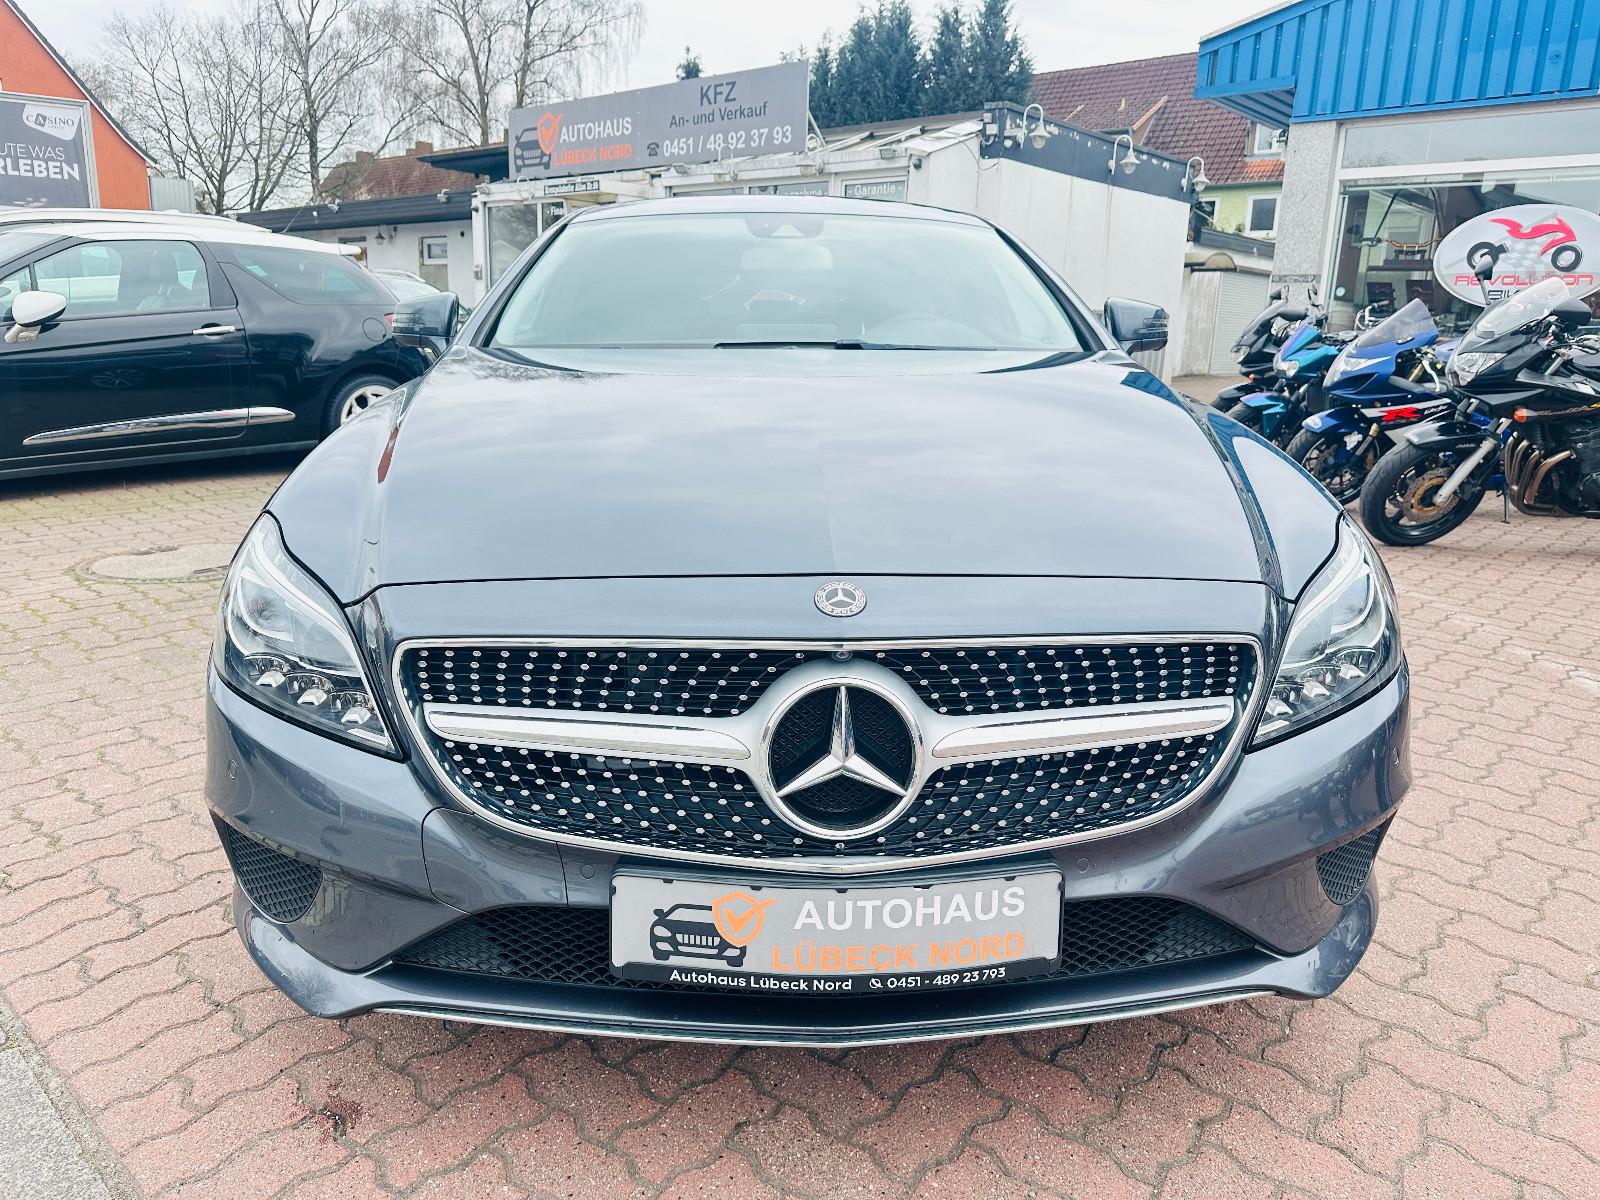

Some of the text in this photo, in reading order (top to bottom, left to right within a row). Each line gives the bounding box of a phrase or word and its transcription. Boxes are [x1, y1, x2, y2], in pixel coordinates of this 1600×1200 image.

[700, 81, 737, 106] KFZ
[26, 112, 75, 128] CASINO
[669, 101, 768, 129] An- und Verkauf
[560, 117, 632, 144] AUTOHAUS
[663, 137, 693, 157] 0451
[706, 133, 724, 151] 48
[727, 131, 746, 150] 92
[750, 128, 769, 147] 37
[772, 125, 792, 145] 93
[28, 144, 65, 160] WAS
[554, 143, 632, 166] LÜBECK NORD
[854, 183, 896, 196] Garantie
[793, 886, 1026, 931] AUTOHAUS
[771, 932, 1025, 972] LÜBECK NORD
[670, 969, 747, 988] Autohaus
[750, 974, 809, 991] Lübeck
[814, 977, 852, 991] Nord
[887, 976, 922, 989] 0451
[933, 974, 959, 987] 489
[962, 971, 980, 984] 23
[982, 967, 1006, 981] 793
